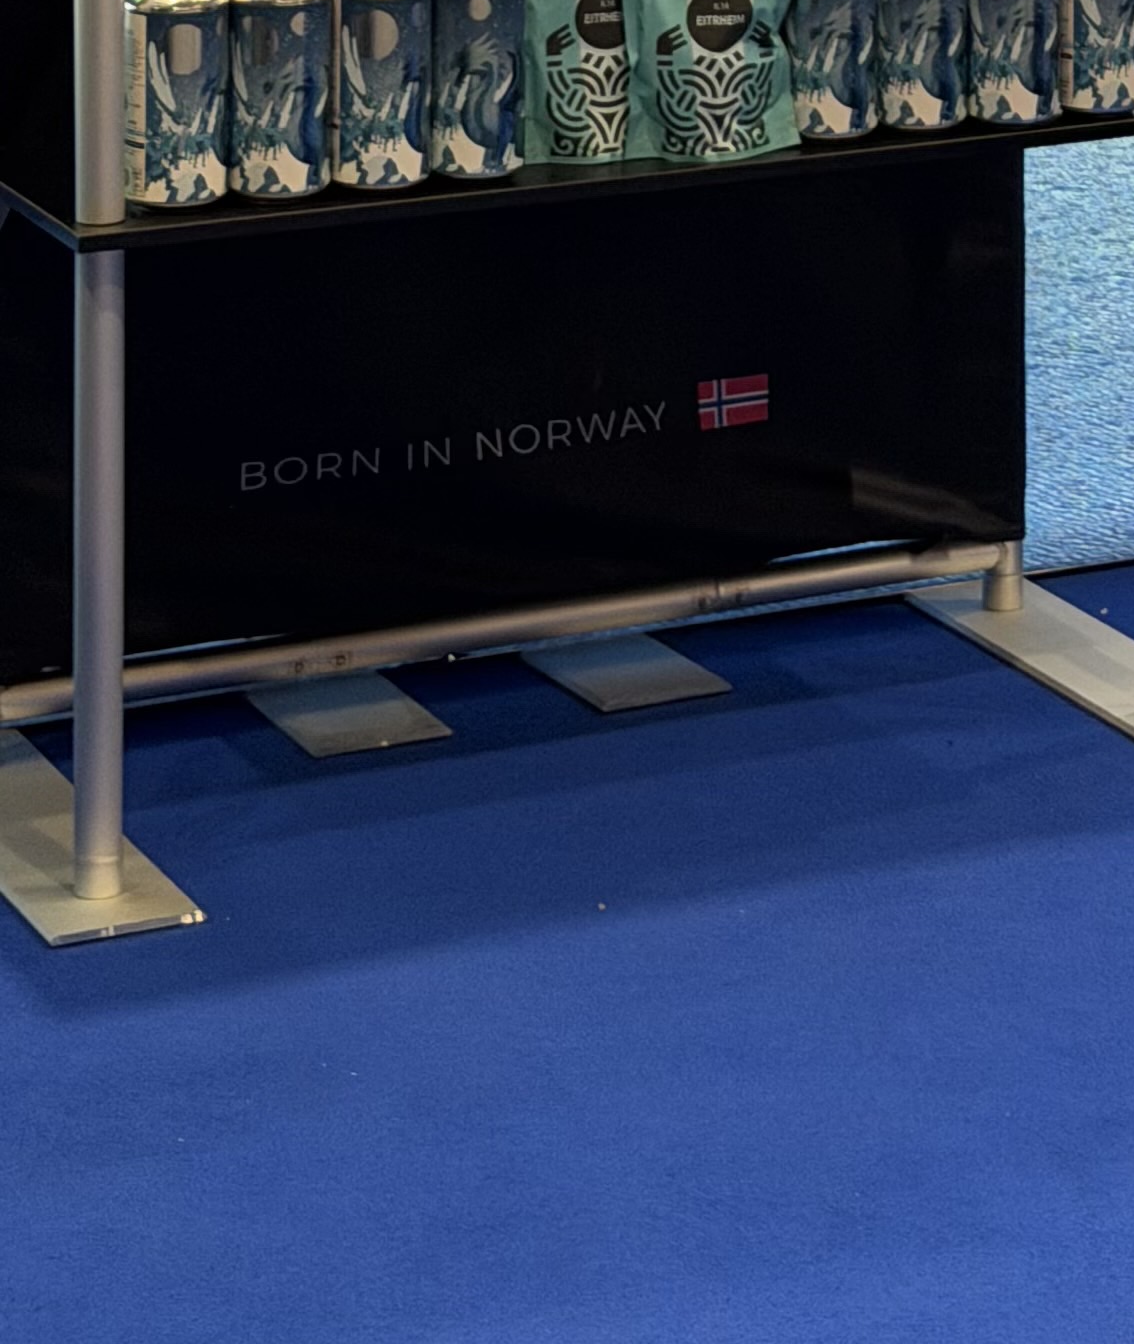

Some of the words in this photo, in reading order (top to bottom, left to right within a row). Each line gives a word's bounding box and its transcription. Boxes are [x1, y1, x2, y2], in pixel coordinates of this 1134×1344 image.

[240, 447, 380, 491] BORN
[407, 437, 451, 470] IN
[476, 400, 666, 461] NORWAY
